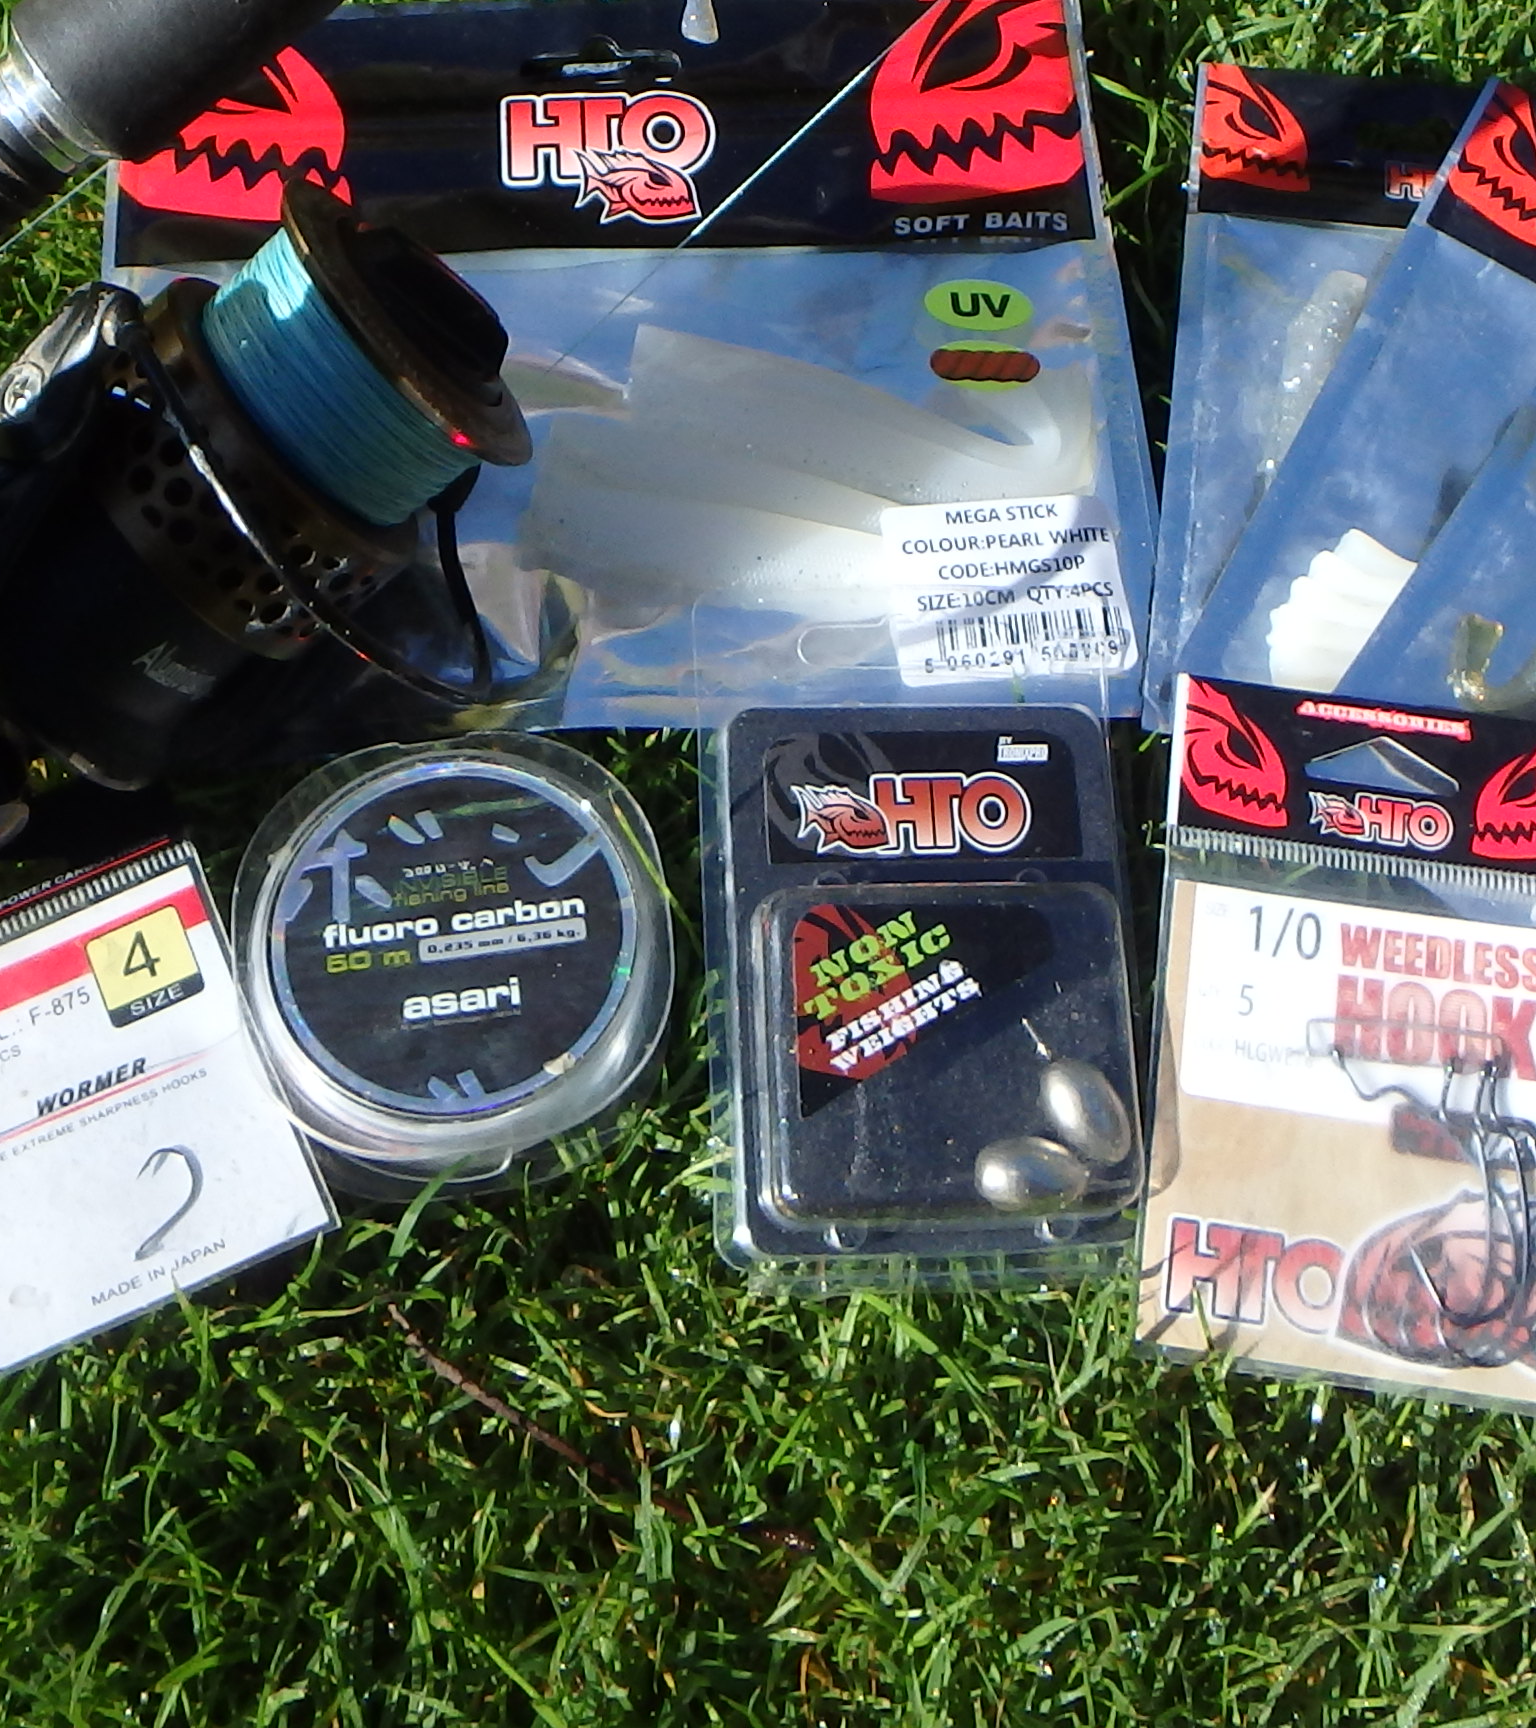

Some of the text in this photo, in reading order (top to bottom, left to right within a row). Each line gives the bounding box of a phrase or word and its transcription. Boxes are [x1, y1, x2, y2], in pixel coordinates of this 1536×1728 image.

[502, 92, 713, 185] HTO
[895, 211, 1068, 235] SOFT BAITS
[950, 292, 1011, 317] UV
[945, 503, 1058, 525] MEGA STICK
[902, 527, 1110, 555] COLOUR:PEARL WHITE
[938, 554, 1085, 580] CODE:HMGS10P
[917, 581, 1113, 612] SIZE:10CM QTY:4PCS
[1297, 700, 1471, 741] ACCESSORIES
[871, 775, 1030, 851] HTO
[1357, 794, 1452, 849] HTO
[473, 881, 511, 898] line
[322, 896, 586, 949] fluoro carbon
[1250, 905, 1322, 960] 1/0
[123, 930, 161, 978] 4
[325, 947, 412, 974] 60 m
[803, 923, 951, 1020] TOXIC
[810, 910, 916, 988] NON
[28, 987, 91, 1026] F-875
[130, 983, 185, 1017] SIZE
[402, 976, 522, 1021] asari
[826, 959, 964, 1052] FISHING
[1237, 984, 1254, 1016] 5
[830, 977, 982, 1074] WEIGHTS
[36, 1057, 147, 1118] WORMER
[12, 1123, 75, 1157] EXTREME
[78, 1089, 159, 1129] SHARPNESS
[161, 1068, 208, 1094] HOOKS
[91, 1238, 226, 1307] MADE IN JAPAN
[1167, 1218, 1344, 1333] HTO
